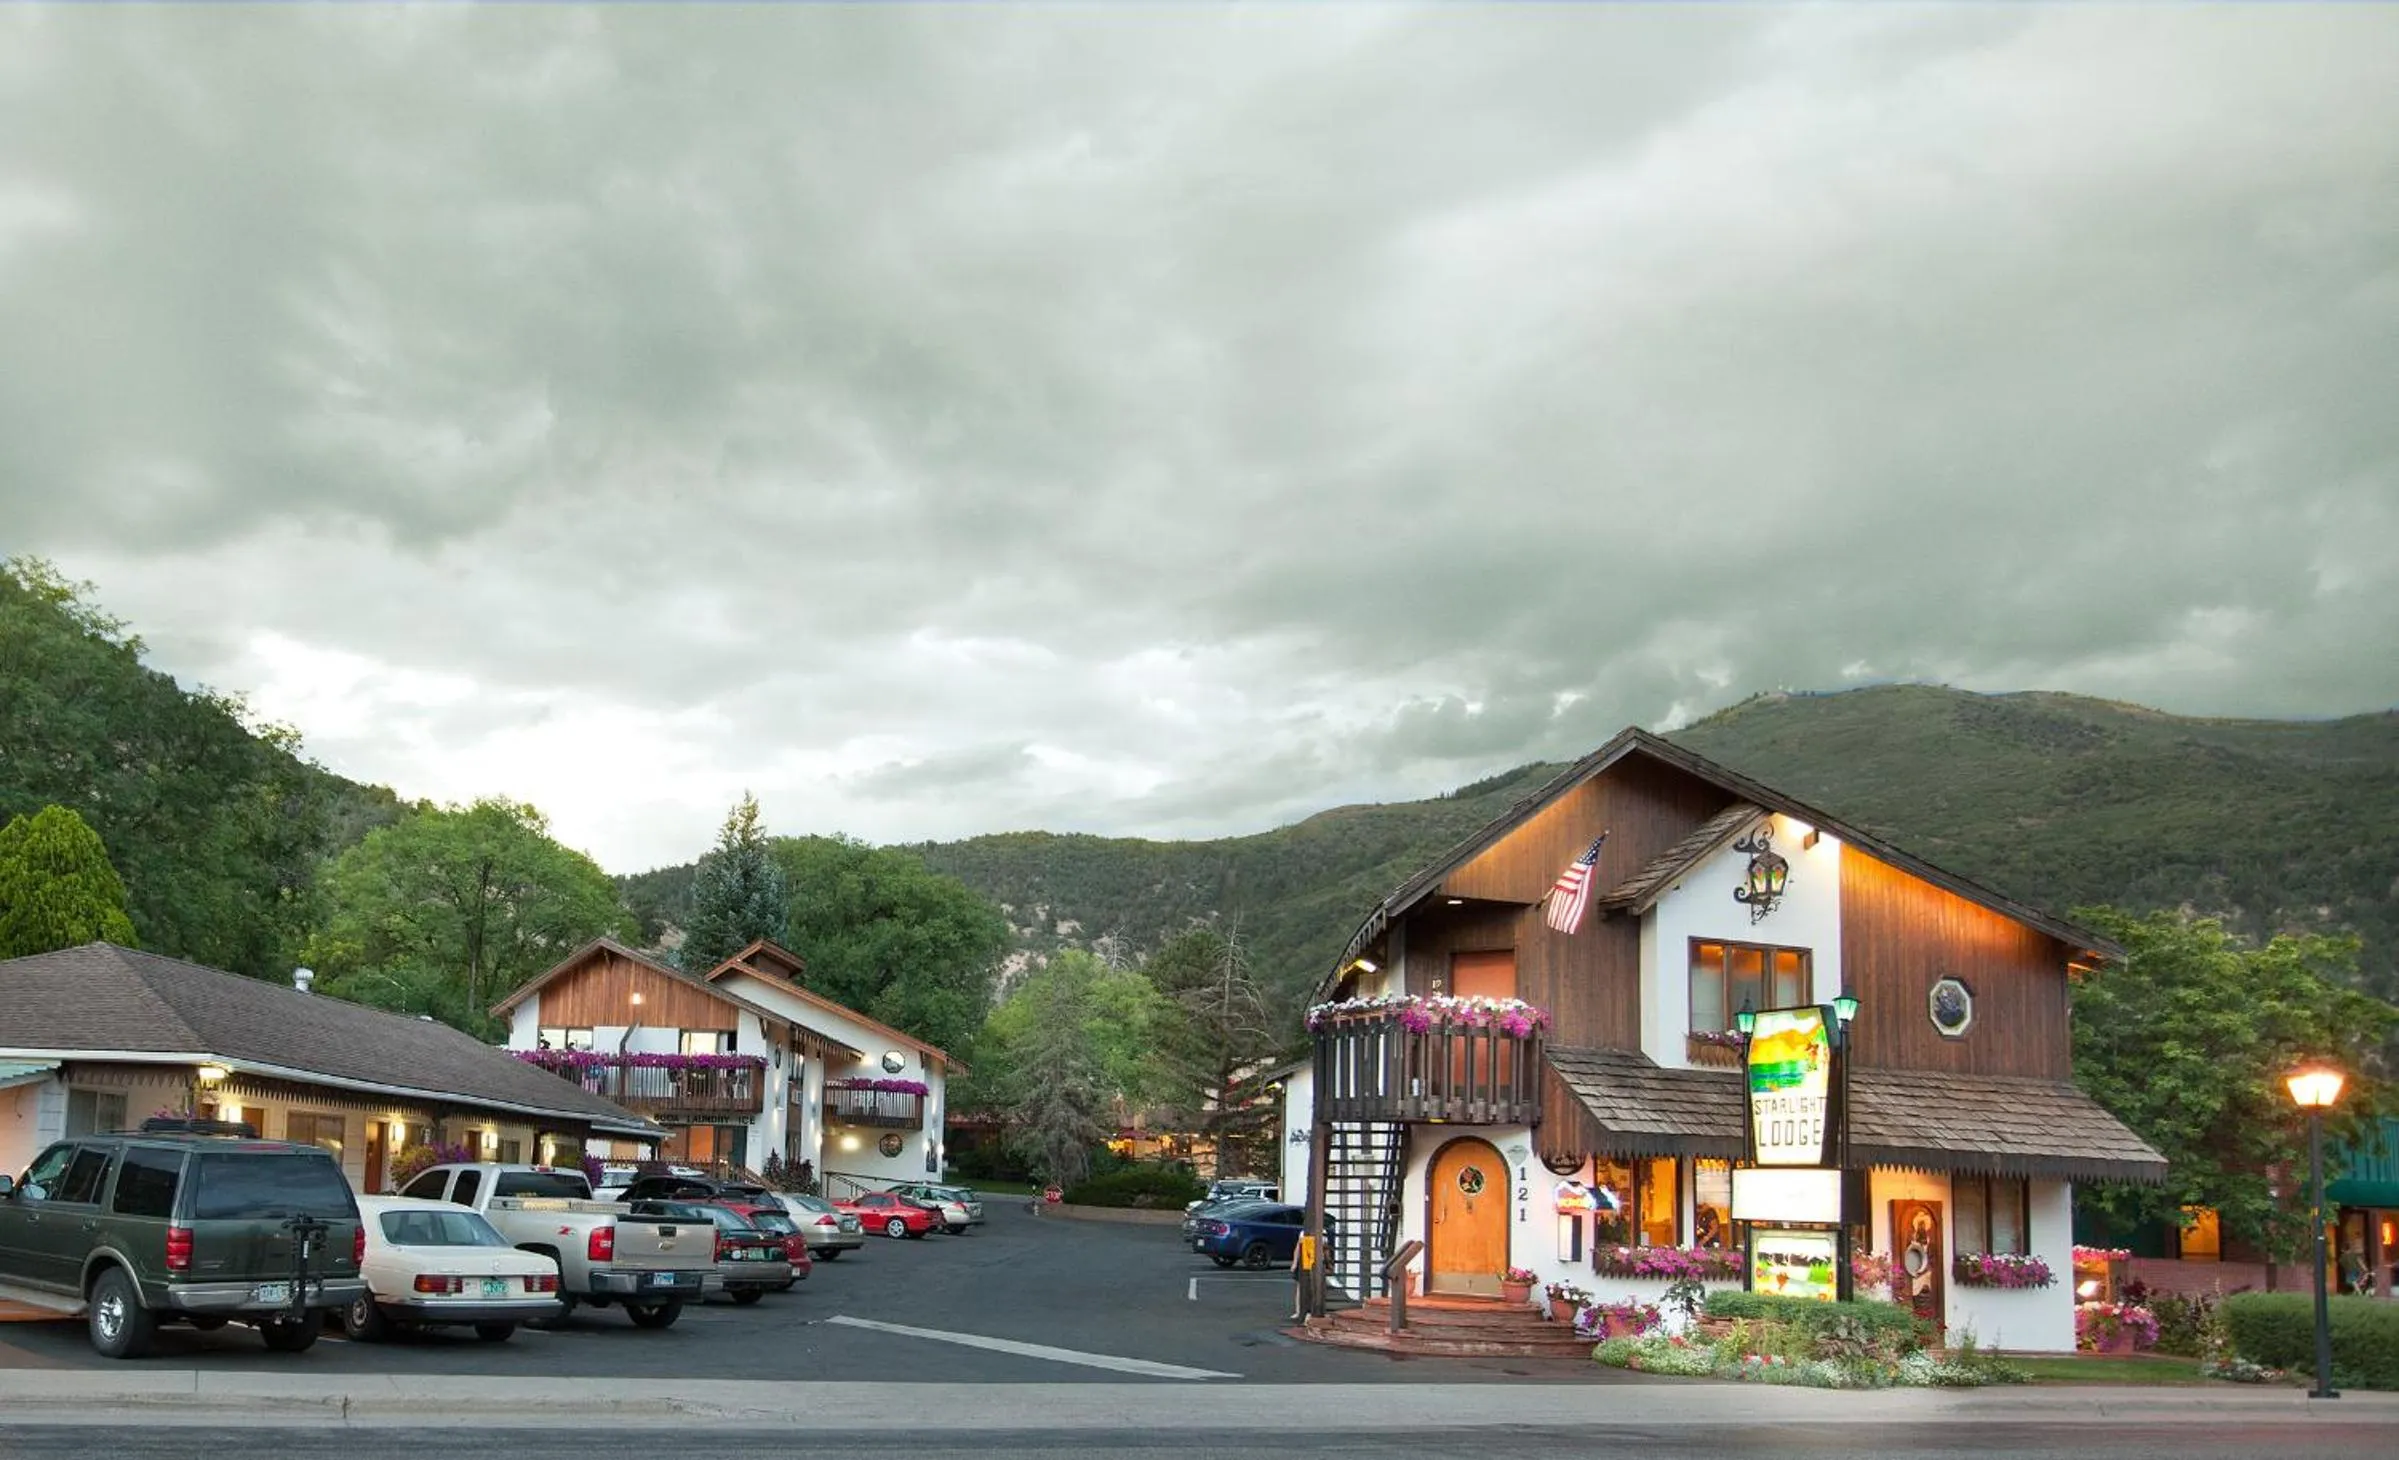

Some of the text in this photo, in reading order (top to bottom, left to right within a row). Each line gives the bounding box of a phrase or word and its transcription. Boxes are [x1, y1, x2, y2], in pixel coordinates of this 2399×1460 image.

[1754, 1096, 1827, 1115] STARLIGHT
[687, 1114, 730, 1124] LAUNDRY
[738, 1115, 756, 1125] ICE
[1759, 1119, 1820, 1147] LODGE
